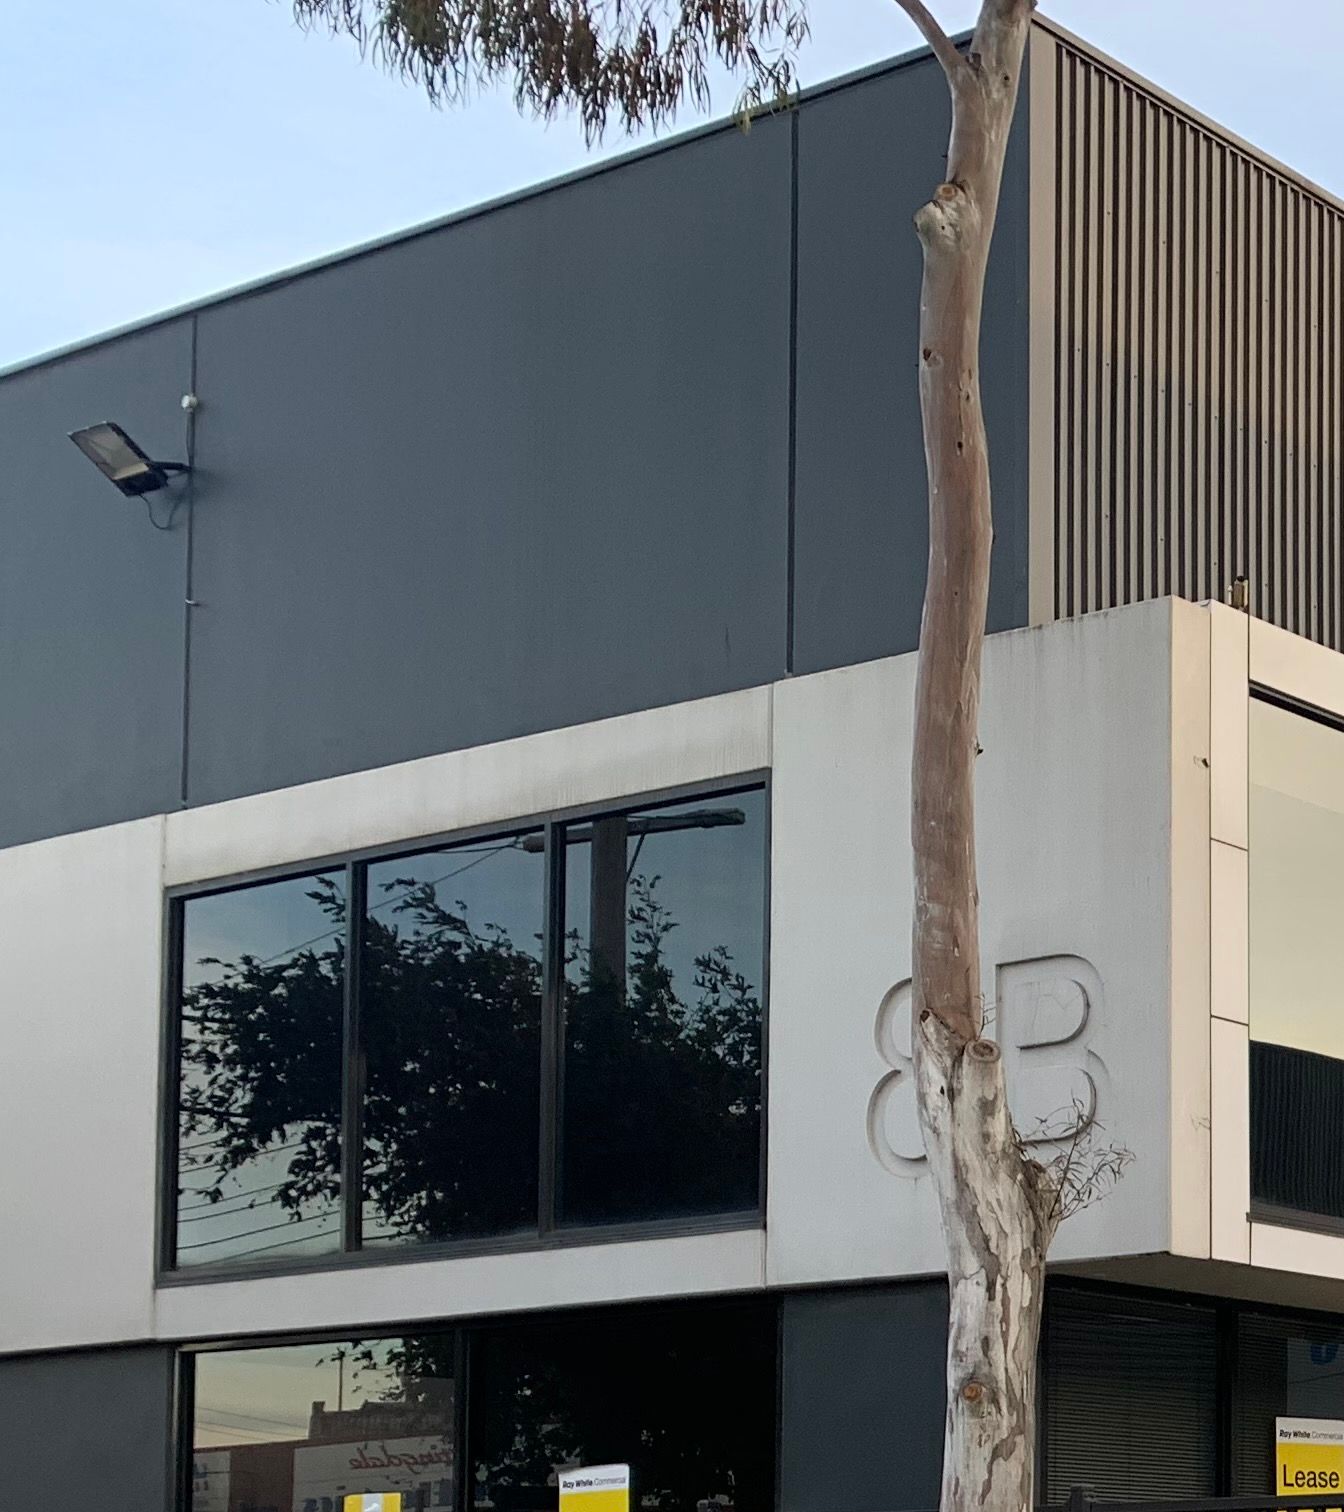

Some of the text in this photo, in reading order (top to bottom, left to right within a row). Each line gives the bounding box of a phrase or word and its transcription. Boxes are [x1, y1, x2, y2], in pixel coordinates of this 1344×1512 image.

[1279, 1429, 1291, 1439] Ray
[1293, 1430, 1311, 1438] White
[1283, 1464, 1340, 1488] Lease
[575, 1478, 593, 1488] White
